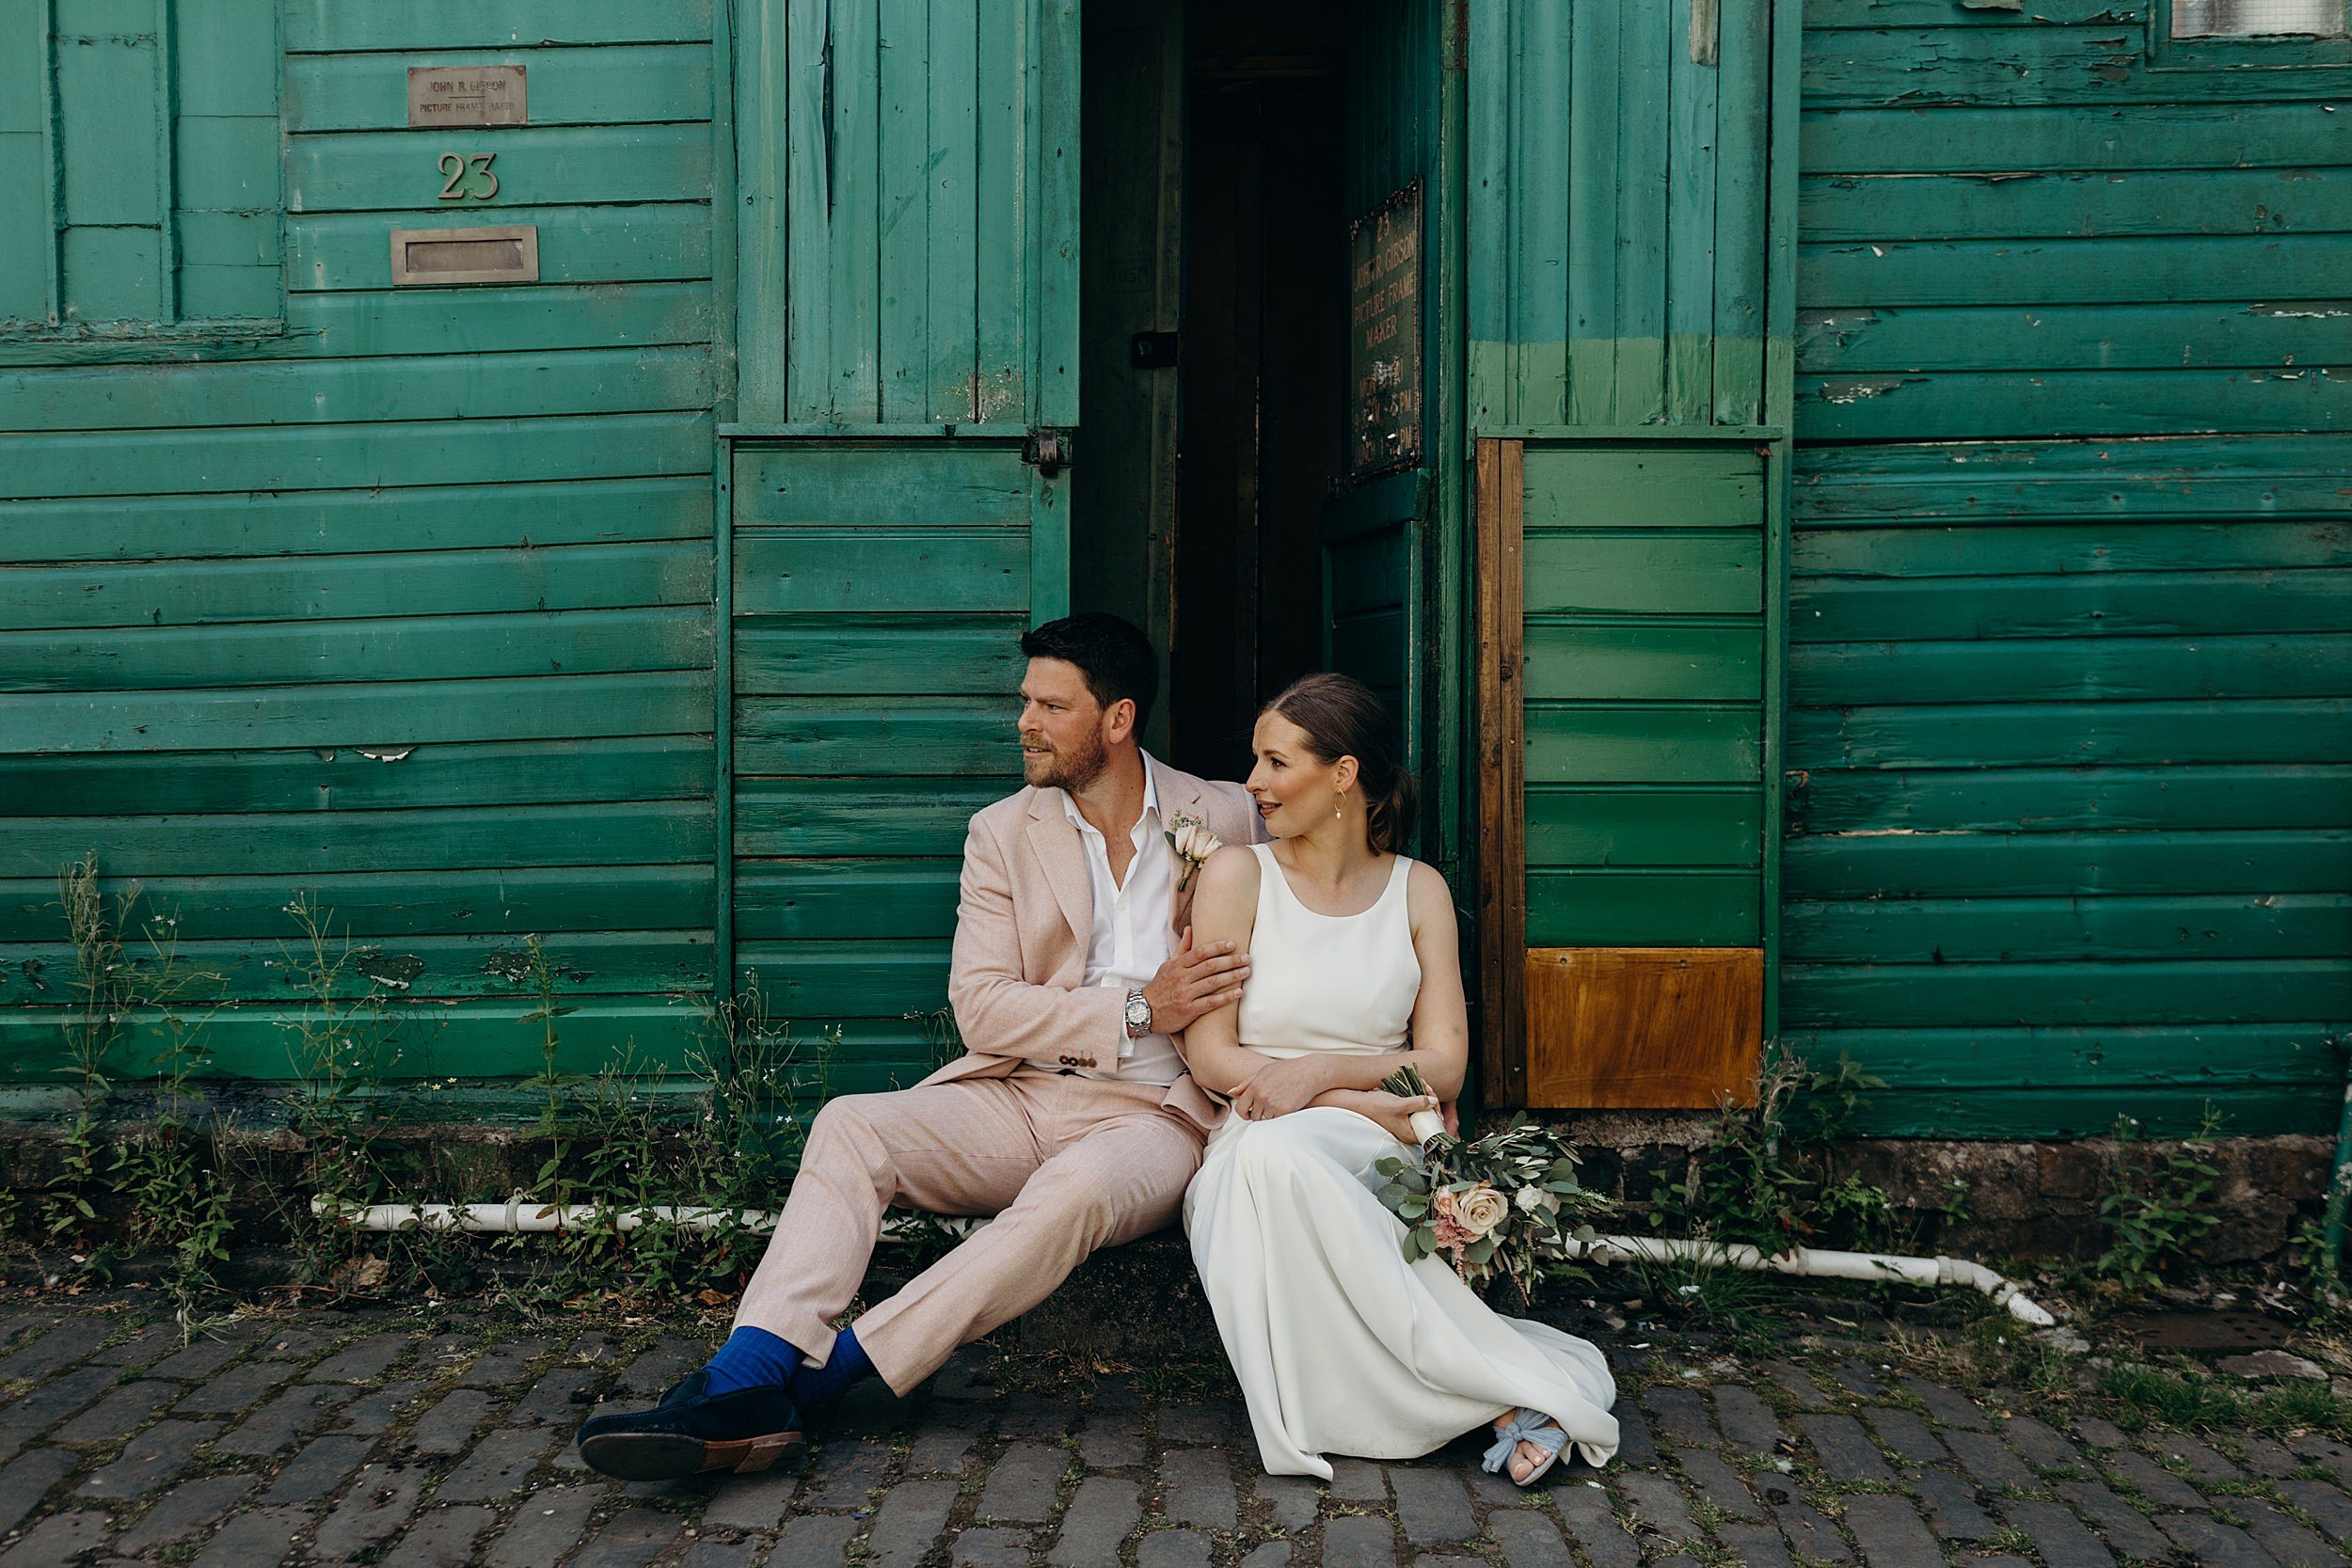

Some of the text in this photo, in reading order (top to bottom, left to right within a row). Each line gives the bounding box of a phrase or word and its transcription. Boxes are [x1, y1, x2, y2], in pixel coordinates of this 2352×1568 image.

[429, 81, 453, 92] JOHN
[420, 103, 453, 113] PICTURE
[455, 102, 483, 112] FRAME
[437, 152, 500, 200] 23
[1376, 210, 1390, 243] 23
[1355, 258, 1375, 292] JOHN
[1385, 230, 1416, 272] GIBSON
[1355, 271, 1414, 327] PICTURE FRAME
[1366, 314, 1397, 350] MAKER
